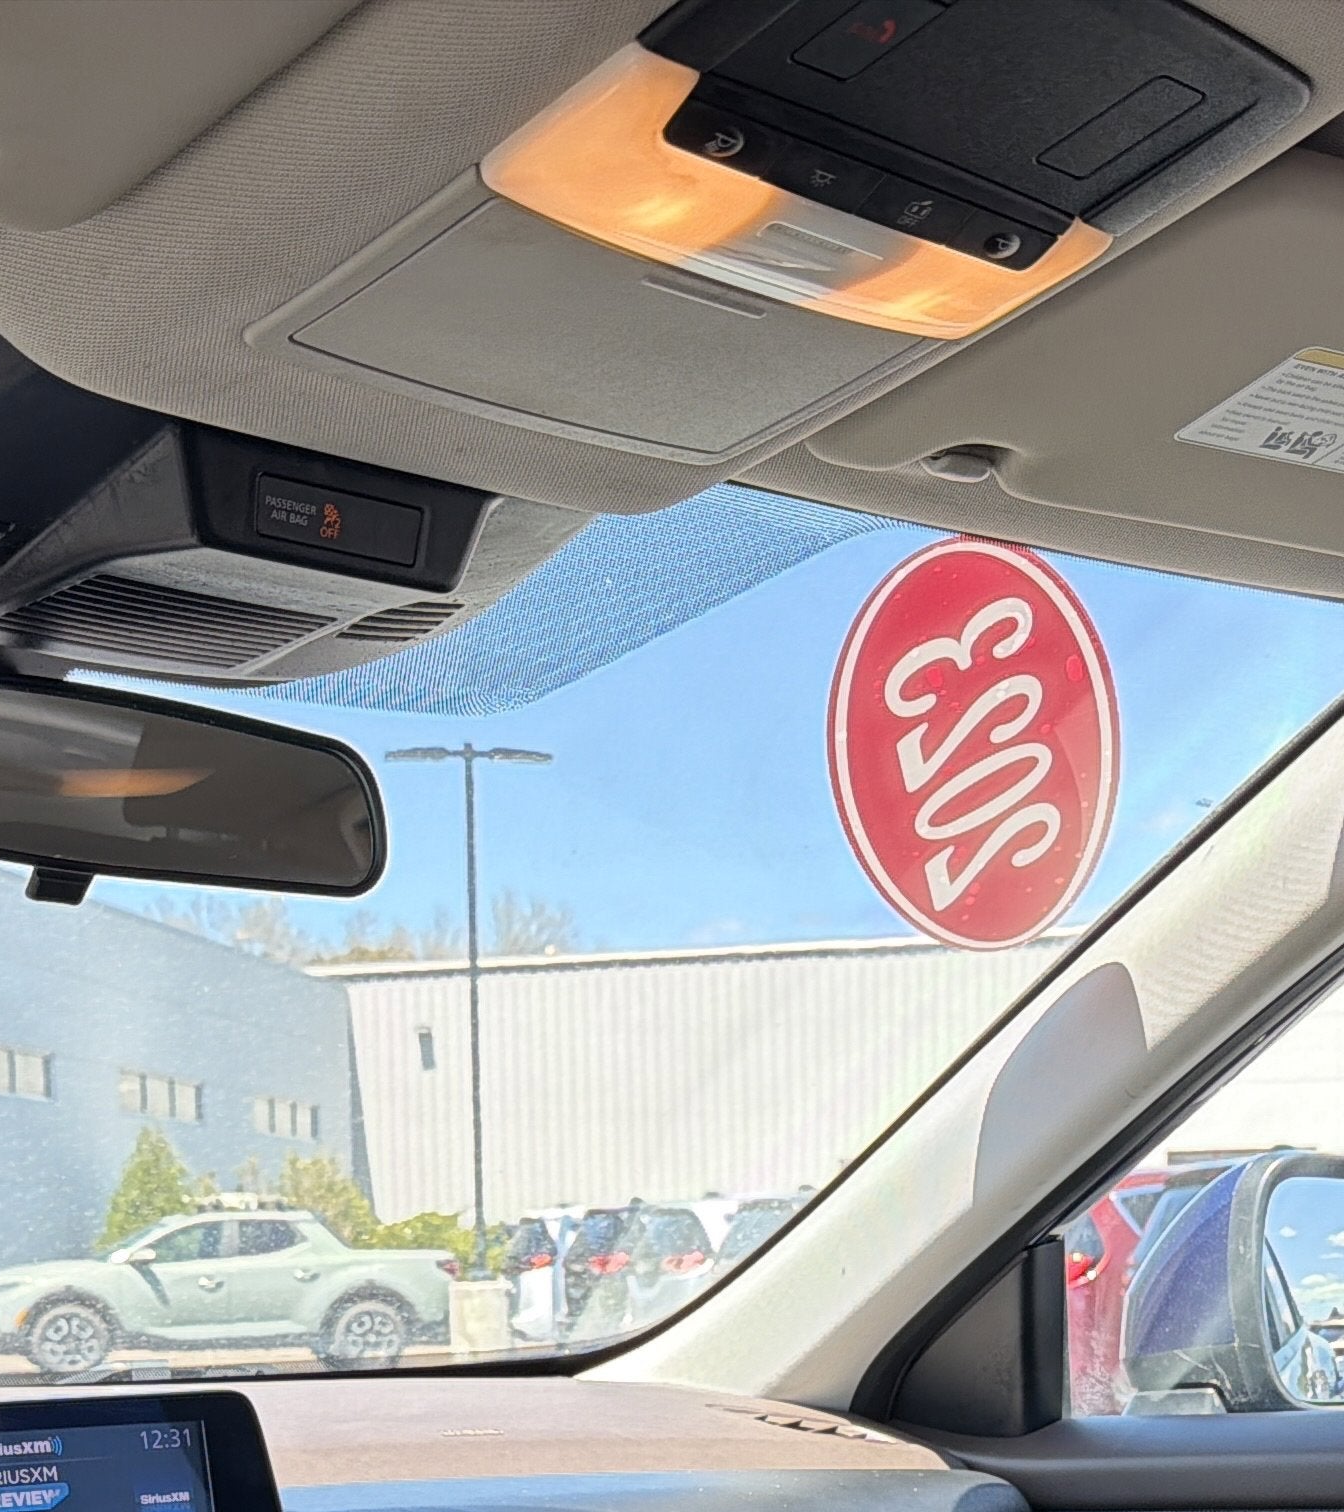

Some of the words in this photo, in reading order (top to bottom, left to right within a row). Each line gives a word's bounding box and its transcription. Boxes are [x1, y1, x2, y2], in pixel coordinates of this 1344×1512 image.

[265, 495, 317, 516] PASSENGER
[270, 508, 287, 521] AIR
[289, 512, 308, 527] BAG
[319, 527, 341, 540] OFF
[139, 1428, 192, 1450] 12:31
